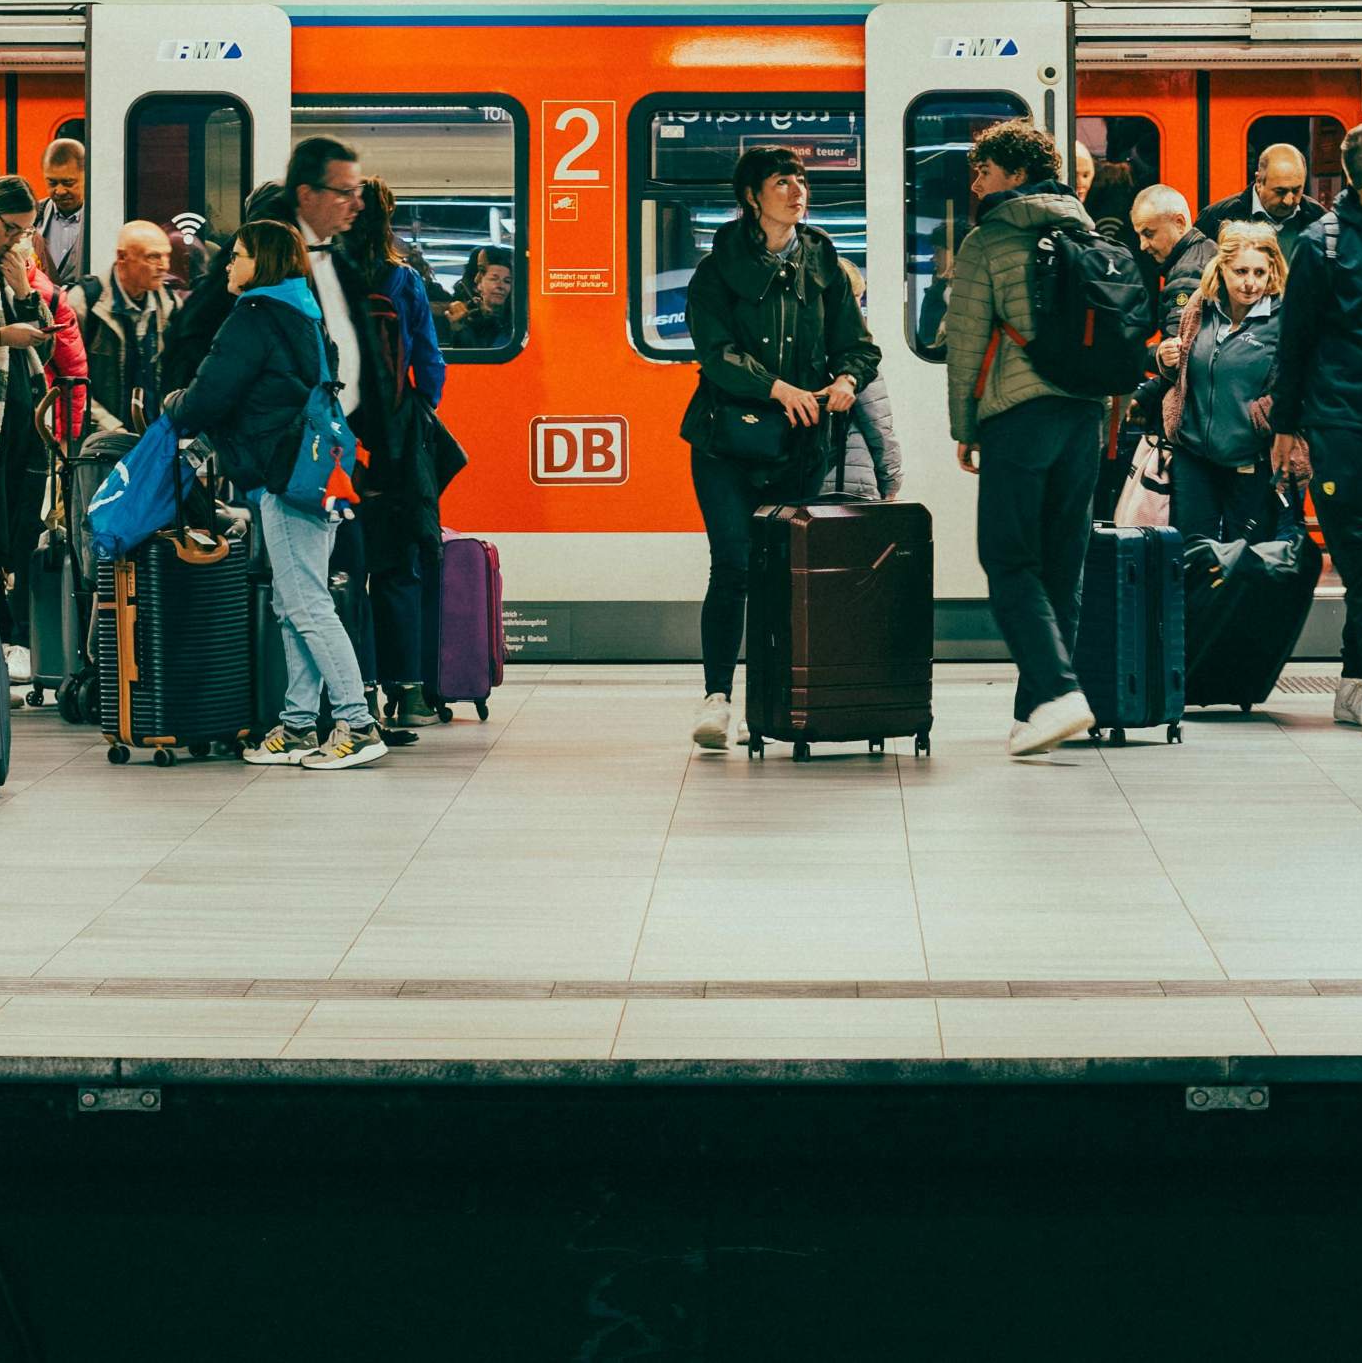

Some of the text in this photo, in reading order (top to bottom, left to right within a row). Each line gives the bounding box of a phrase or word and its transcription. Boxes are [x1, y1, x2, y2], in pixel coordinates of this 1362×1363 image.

[175, 40, 234, 59] RMV
[951, 37, 1011, 57] RMV
[554, 108, 600, 181] 2
[816, 146, 845, 157] teuer
[543, 427, 617, 473] DB
